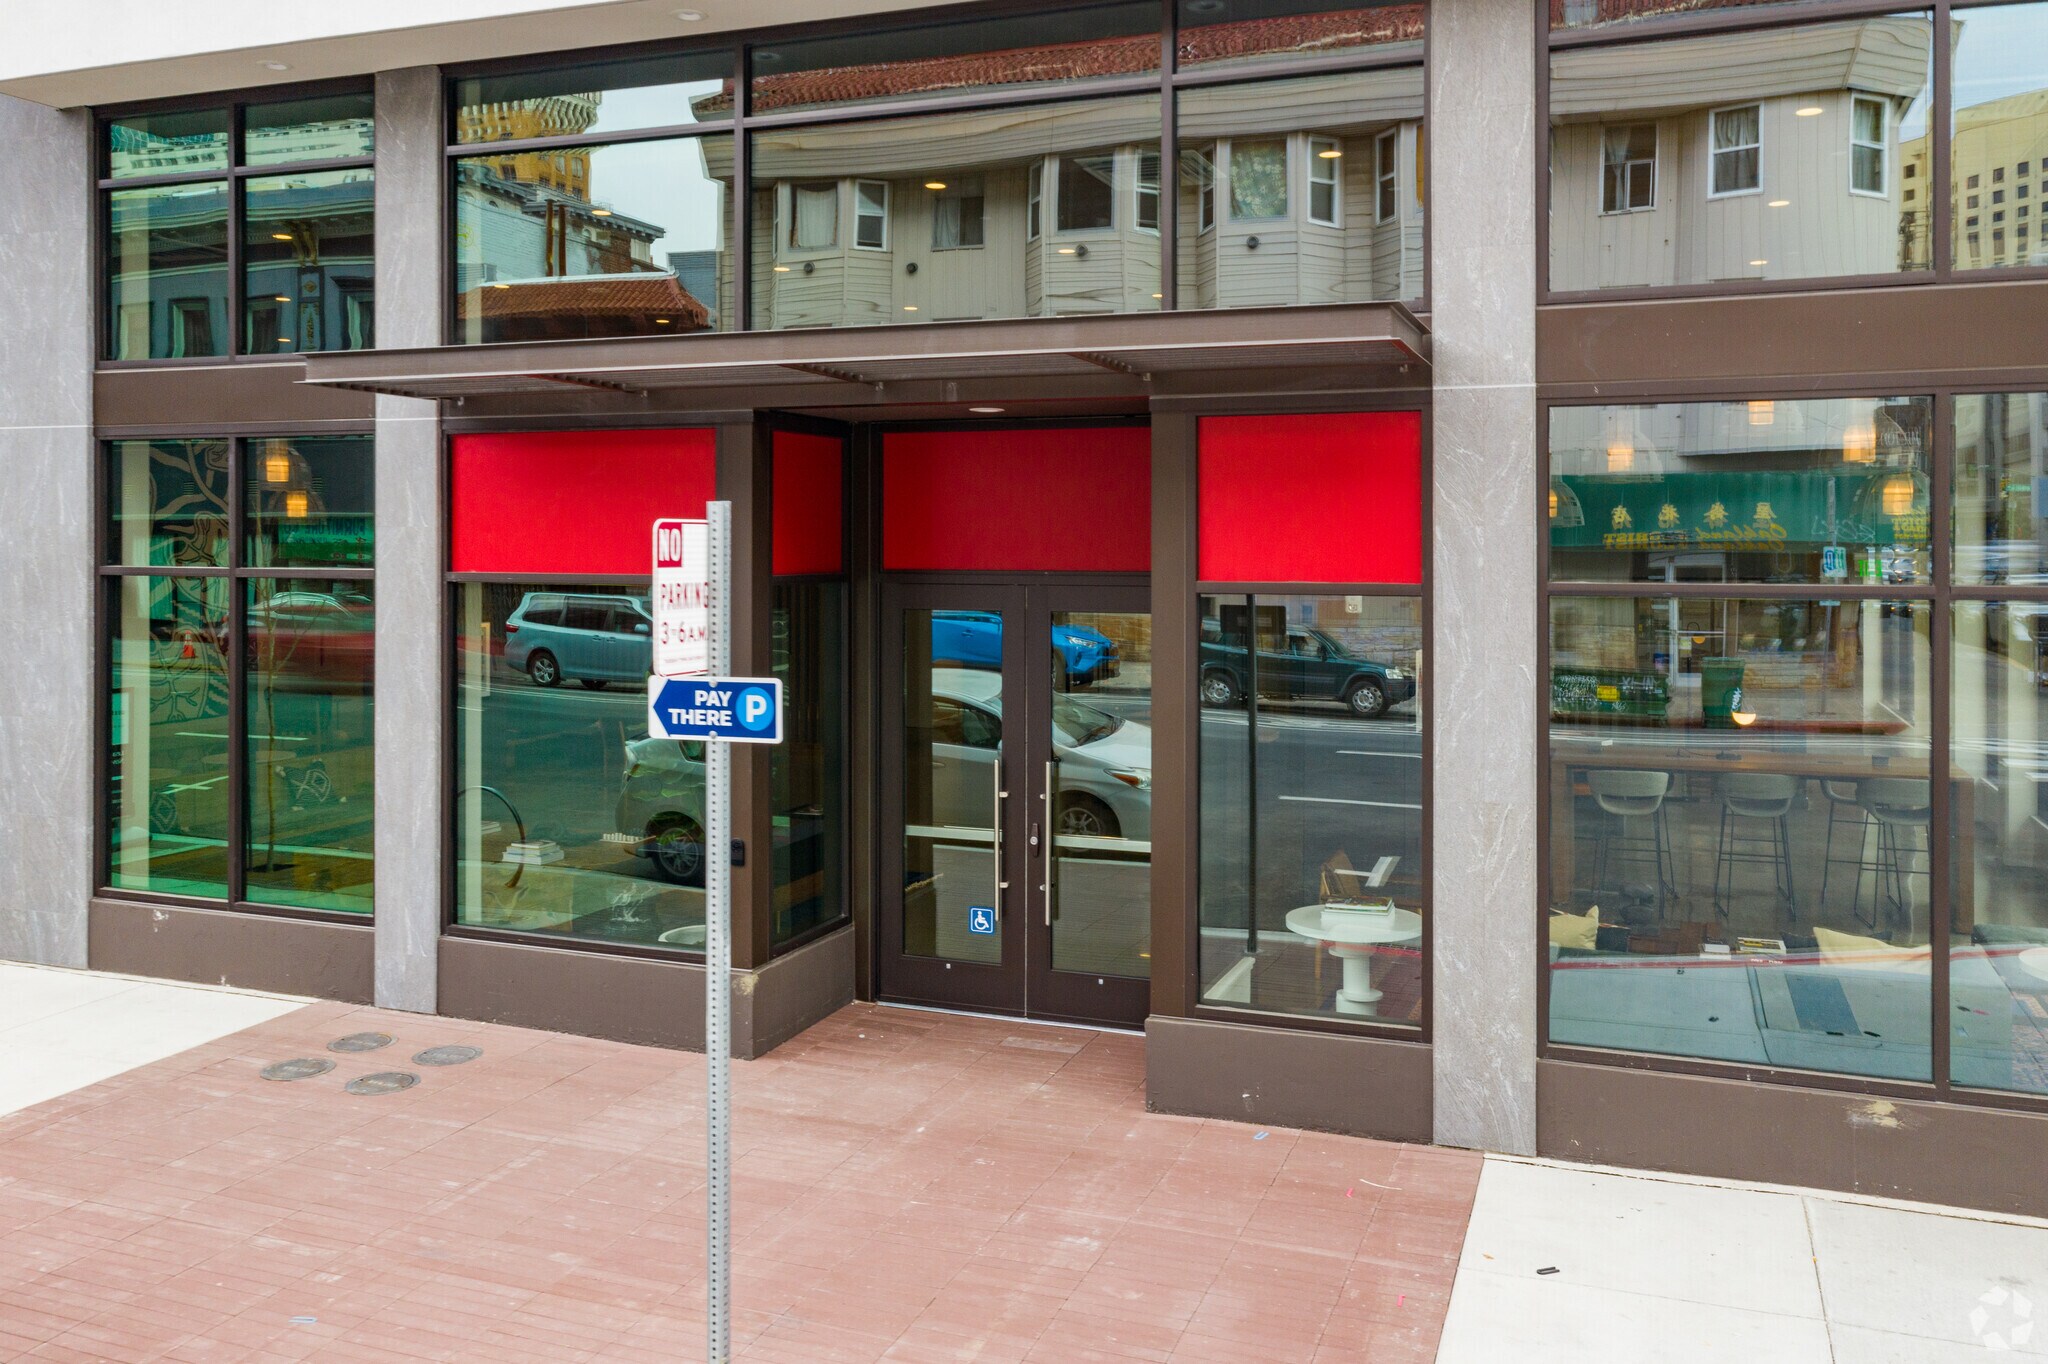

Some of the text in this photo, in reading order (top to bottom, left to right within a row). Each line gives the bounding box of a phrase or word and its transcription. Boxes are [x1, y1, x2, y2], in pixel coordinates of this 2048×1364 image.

[658, 528, 682, 562] NO
[661, 582, 709, 609] PARKING
[667, 708, 733, 727] THERE
[694, 690, 767, 723] PAY P
